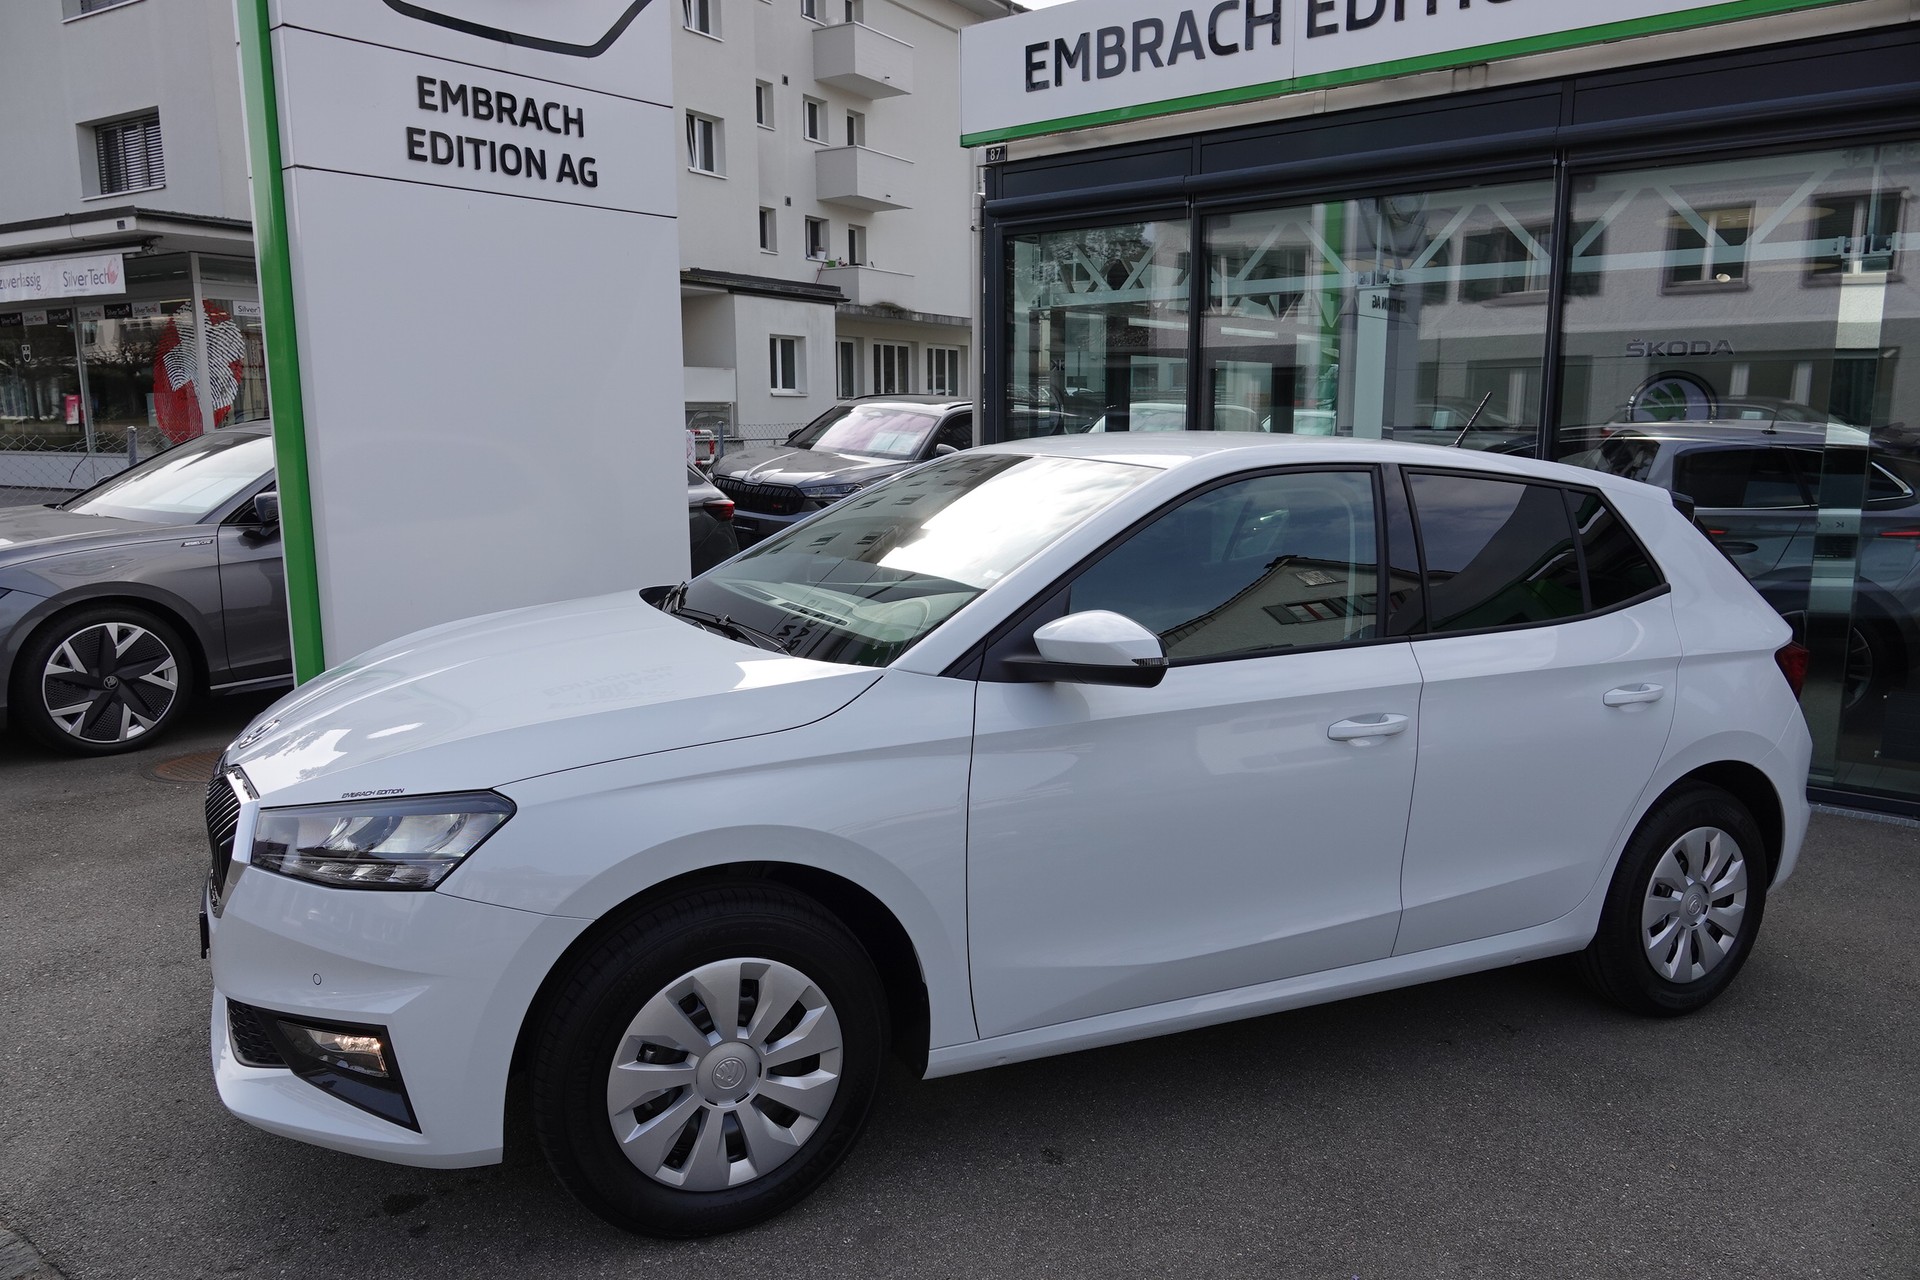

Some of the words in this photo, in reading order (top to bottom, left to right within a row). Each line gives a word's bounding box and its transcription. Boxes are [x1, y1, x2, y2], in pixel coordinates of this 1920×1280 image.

[1025, 0, 1282, 93] EMBRACH
[417, 75, 585, 138] EMBRACH
[406, 126, 547, 180] EDITION
[555, 153, 599, 188] AG
[990, 148, 1001, 161] 87
[1625, 338, 1736, 357] ŠKODA
